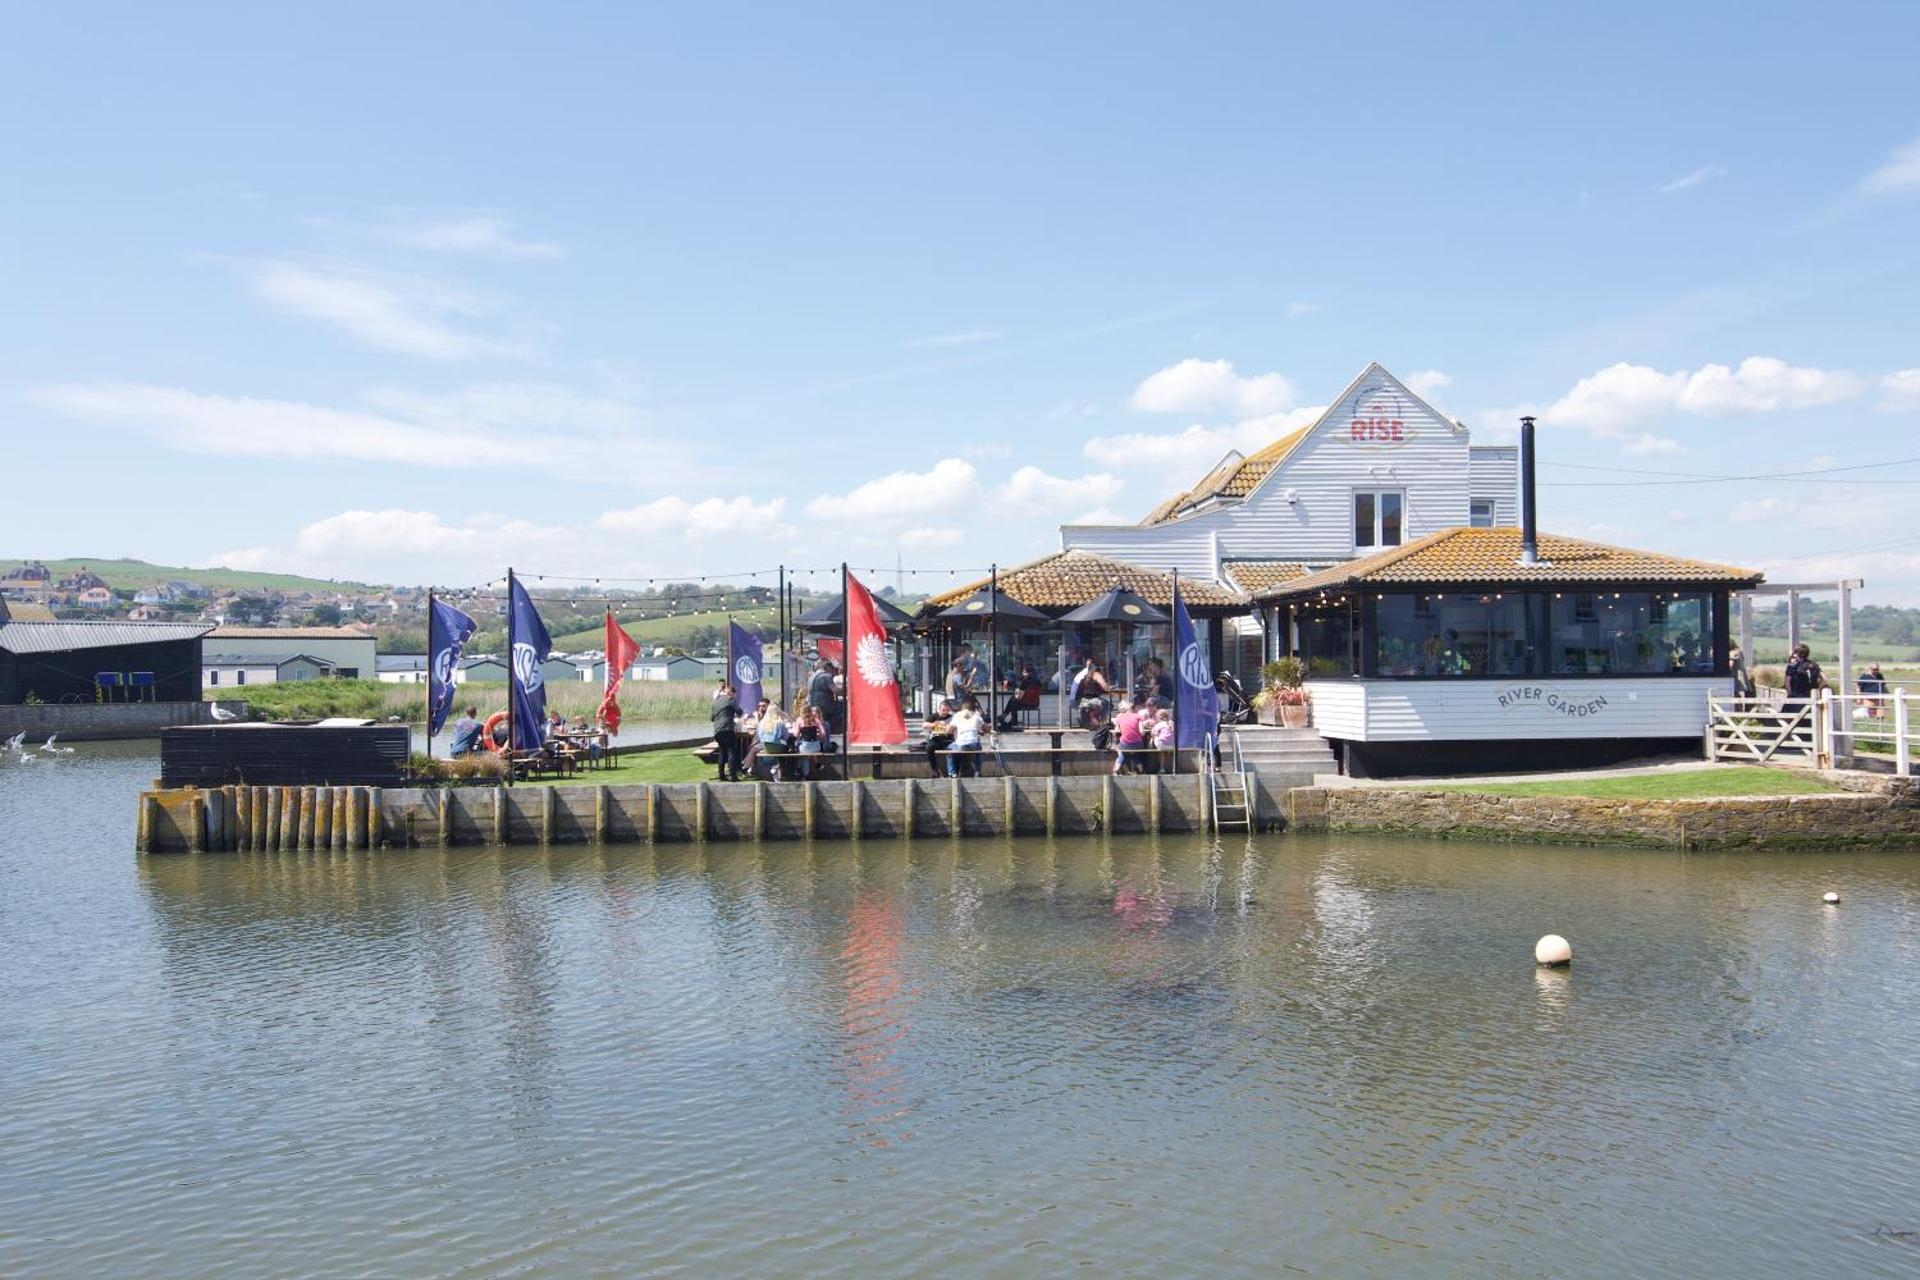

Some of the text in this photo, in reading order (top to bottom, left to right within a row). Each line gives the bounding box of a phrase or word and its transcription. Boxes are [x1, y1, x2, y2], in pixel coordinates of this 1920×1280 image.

[1351, 418, 1404, 441] RISE
[1185, 646, 1210, 686] RIS
[1498, 687, 1608, 717] RIVER GARDEN
